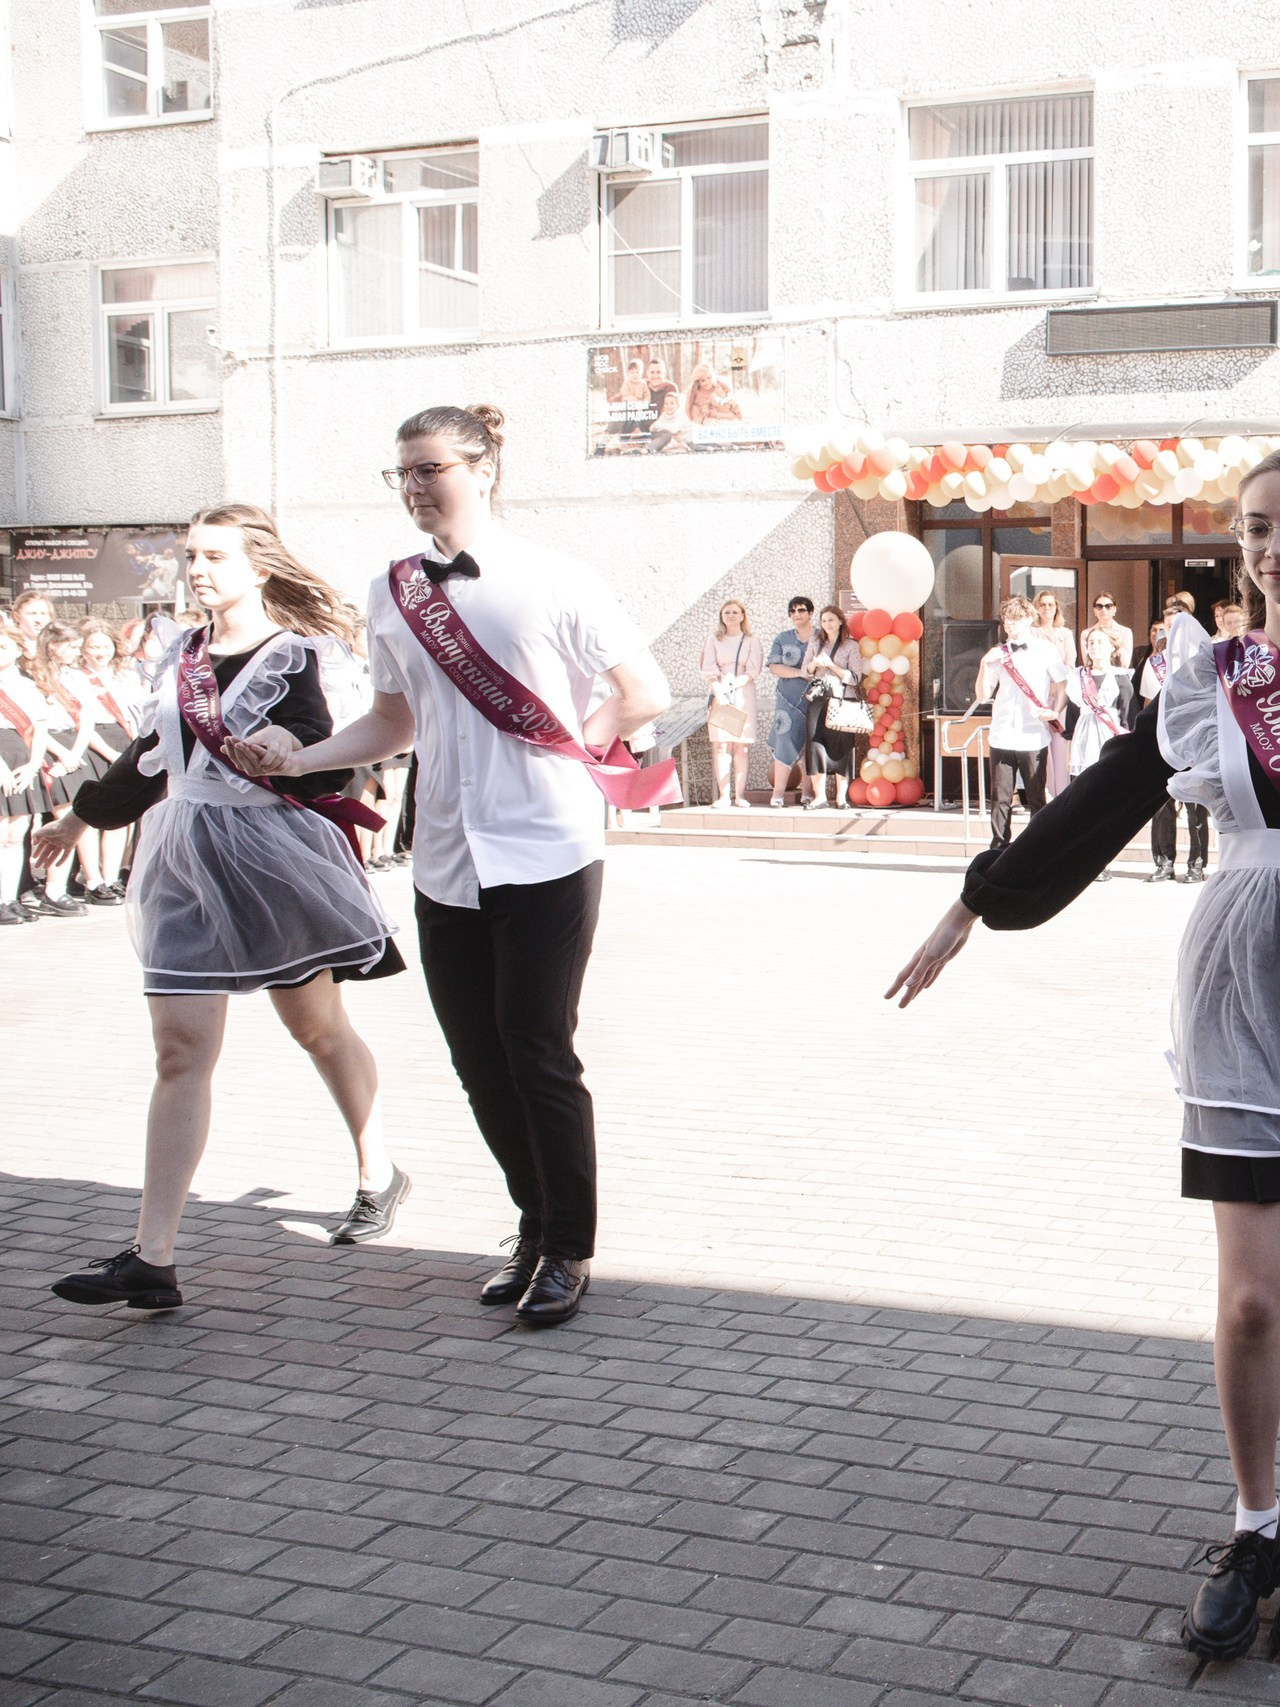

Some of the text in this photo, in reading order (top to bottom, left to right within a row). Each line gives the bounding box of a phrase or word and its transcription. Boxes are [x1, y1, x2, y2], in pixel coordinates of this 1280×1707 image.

[727, 427, 750, 438] БЫТЬ
[751, 425, 782, 437] ВМЕСТЕ
[16, 548, 99, 561] ДЖИУ-ДЖИТСУ
[419, 602, 514, 712] Выпускник
[419, 630, 439, 650] МАОУ
[448, 666, 465, 685] СОШ
[455, 629, 505, 685] Пронин Александр
[1250, 722, 1275, 752] МАОУ
